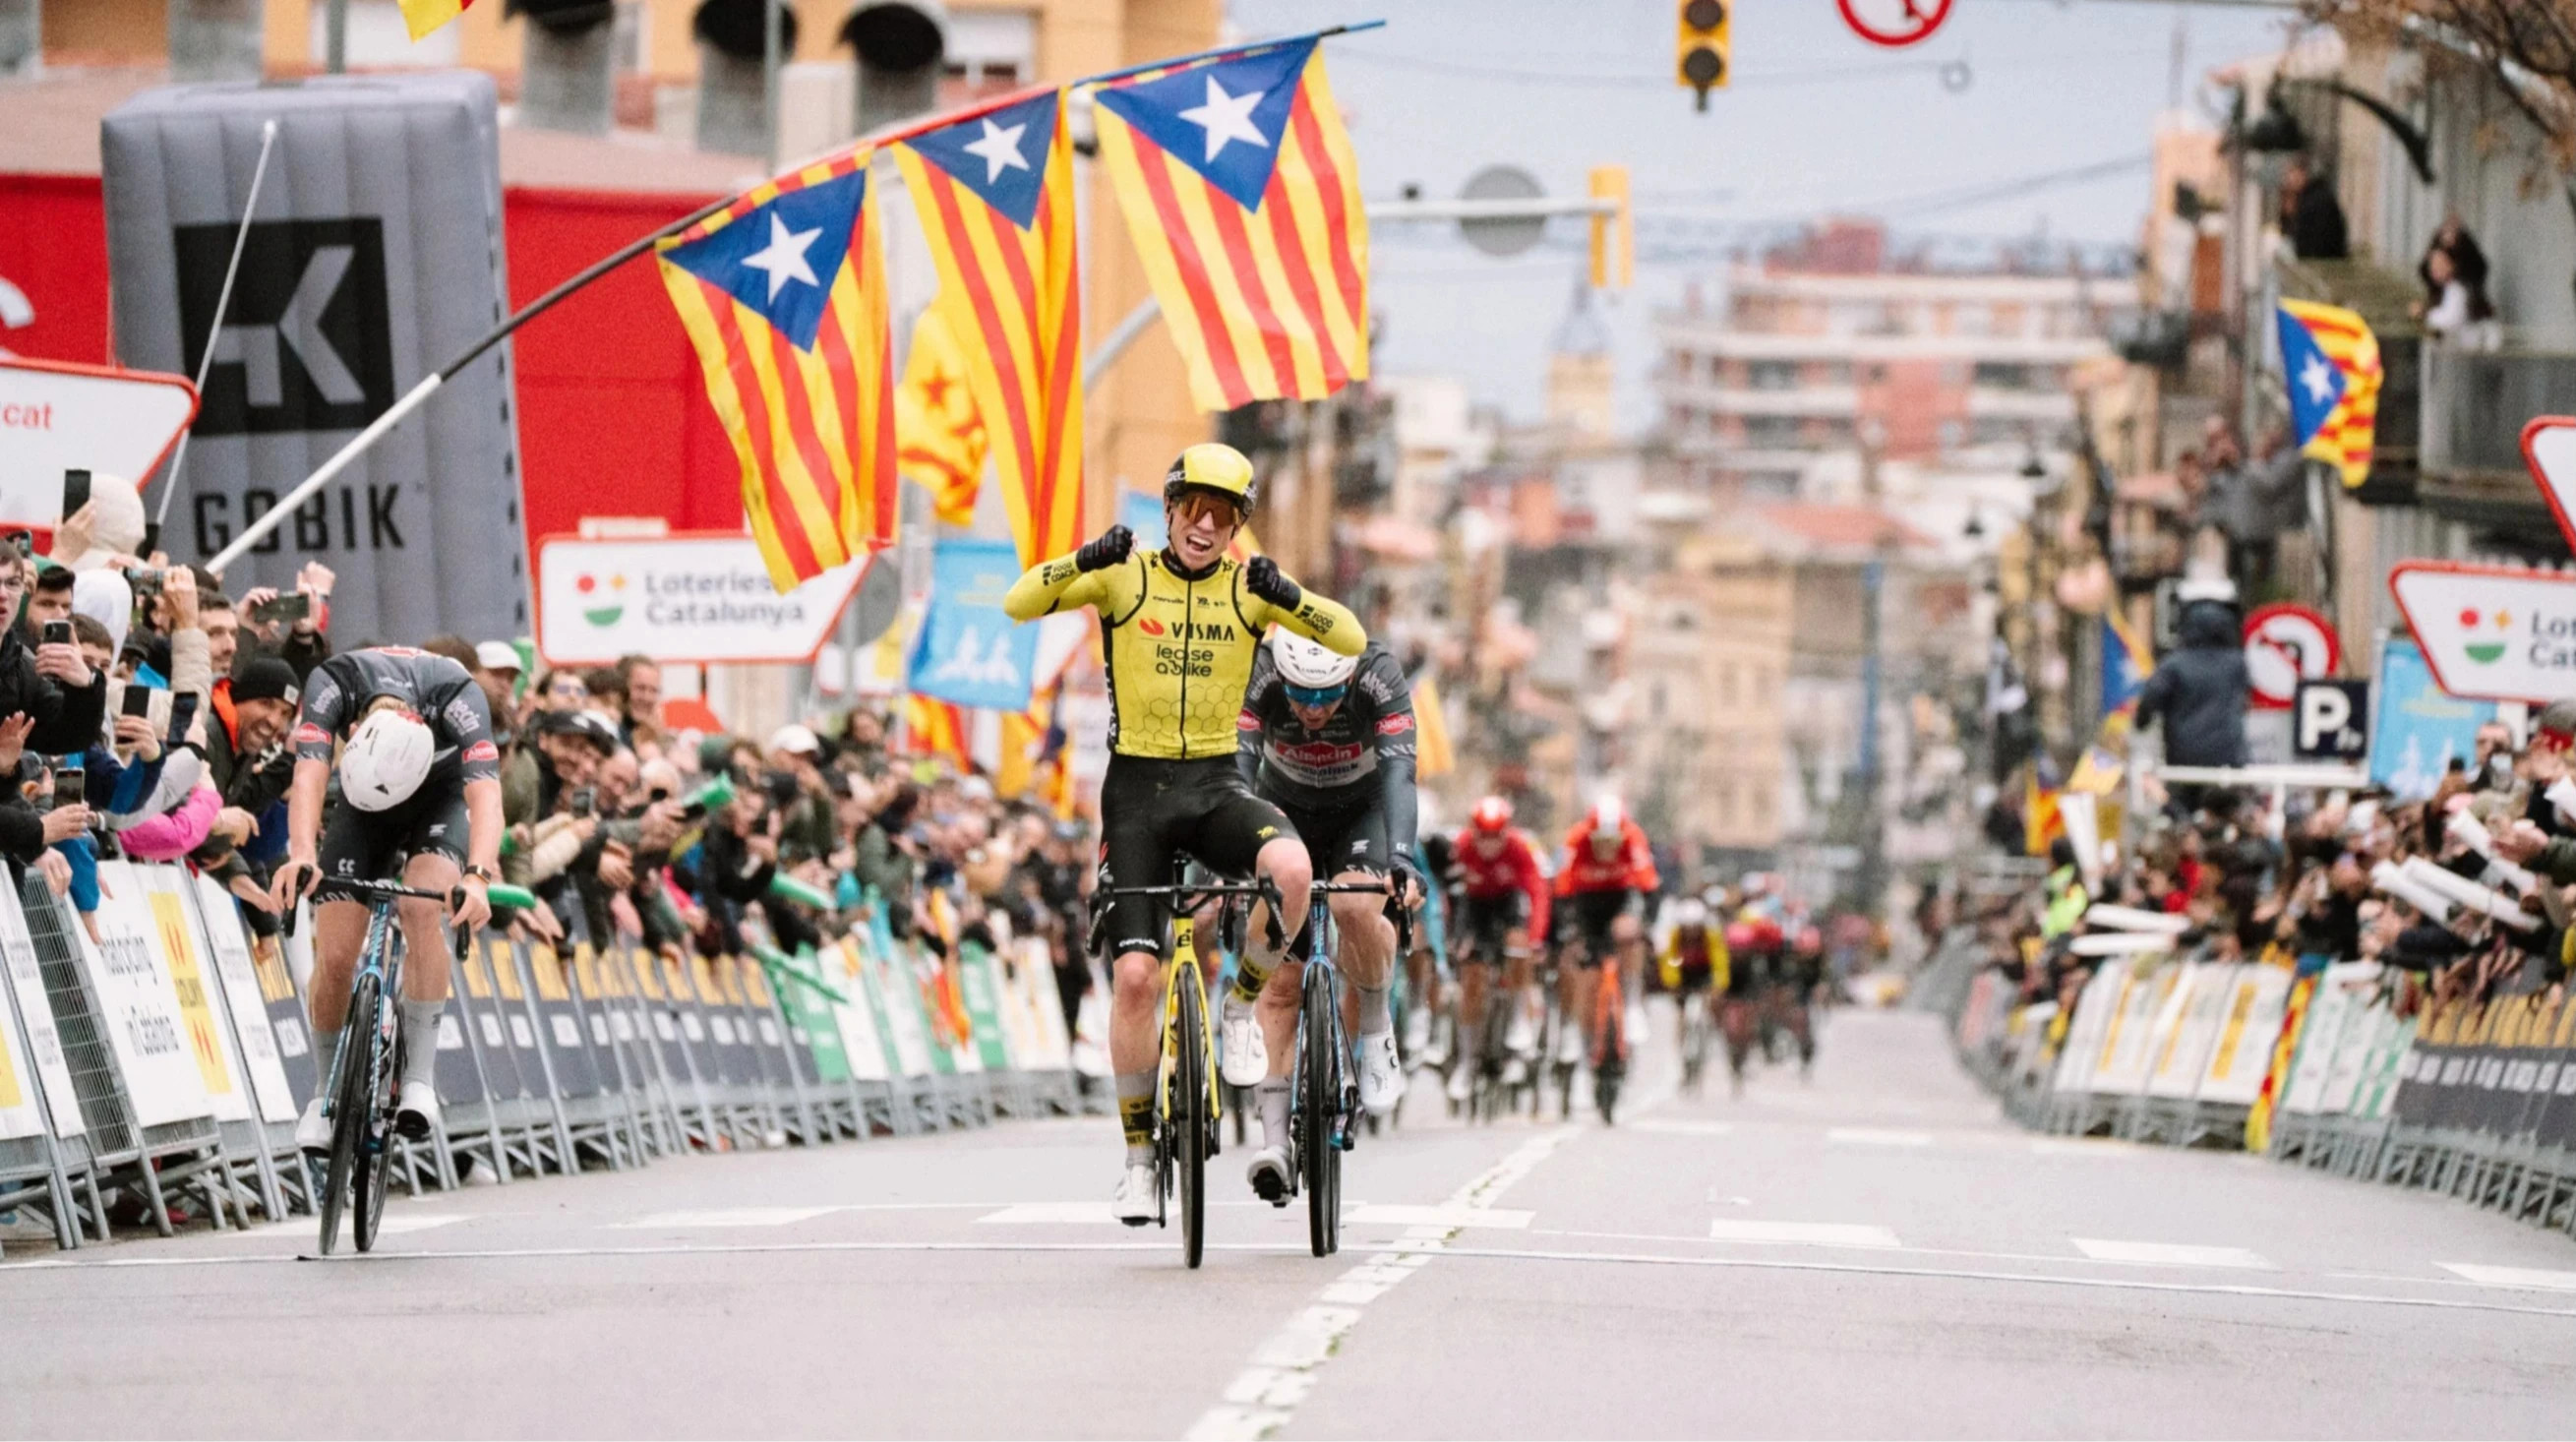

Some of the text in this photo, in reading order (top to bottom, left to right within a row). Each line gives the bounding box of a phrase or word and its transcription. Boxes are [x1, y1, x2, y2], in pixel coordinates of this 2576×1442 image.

[193, 483, 405, 558] GOBIK
[644, 597, 805, 631] Catalunya
[1171, 621, 1235, 642] VISMA
[1156, 643, 1215, 663] lease
[2301, 686, 2351, 750] P
